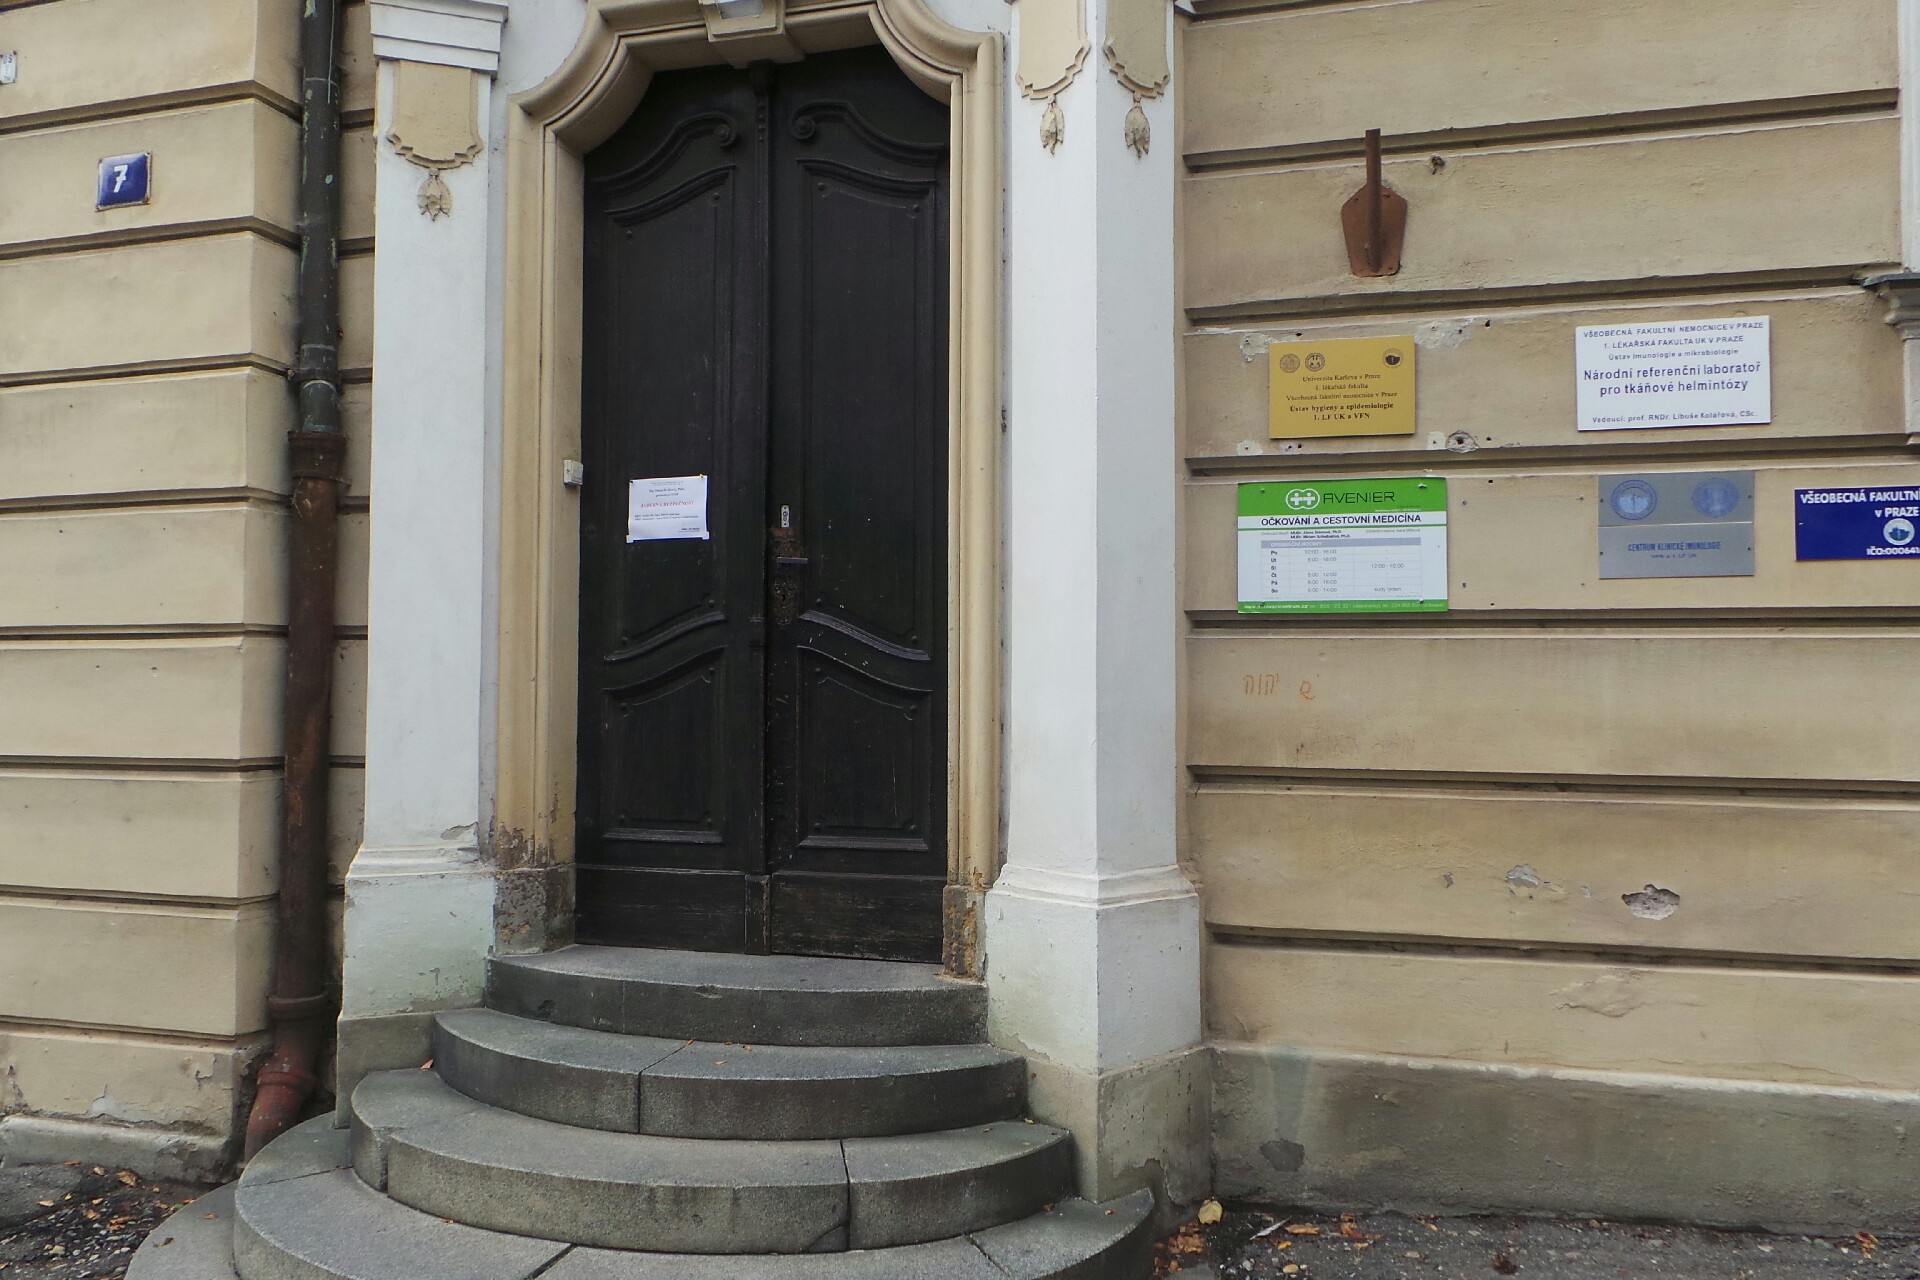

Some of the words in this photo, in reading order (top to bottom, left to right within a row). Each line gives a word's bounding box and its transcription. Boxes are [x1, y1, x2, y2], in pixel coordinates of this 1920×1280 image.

[114, 164, 128, 192] 7
[1584, 327, 1632, 338] VŠEOBECNÁ
[1636, 325, 1676, 335] FAKULTNÍ
[1679, 323, 1728, 332] NEMOCNICE
[1612, 338, 1656, 348] LÉKAŘSKÁ
[1608, 352, 1631, 360] Ústav
[1633, 350, 1676, 360] imunologie
[1684, 348, 1738, 357] mikrobiologie
[1584, 368, 1633, 380] Národní
[1636, 365, 1700, 378] referenční
[1704, 362, 1761, 374] laboratoř
[1600, 386, 1621, 397] pro
[1624, 382, 1674, 394] tkáňové
[1678, 378, 1748, 392] helmintózy
[1346, 402, 1394, 410] epidemiologie
[1672, 412, 1698, 420] Libuše
[1323, 491, 1395, 504] AVENIER
[1800, 489, 1867, 504] VŠEOBECNÁ
[1875, 510, 1882, 518] v
[1884, 506, 1919, 517] PRAZE
[1261, 516, 1310, 526] OČKOVÁNÍ
[1322, 514, 1370, 525] CESTOVNÍ
[1373, 513, 1421, 524] MEDICÍNA
[1866, 546, 1920, 555] IČO:000641
